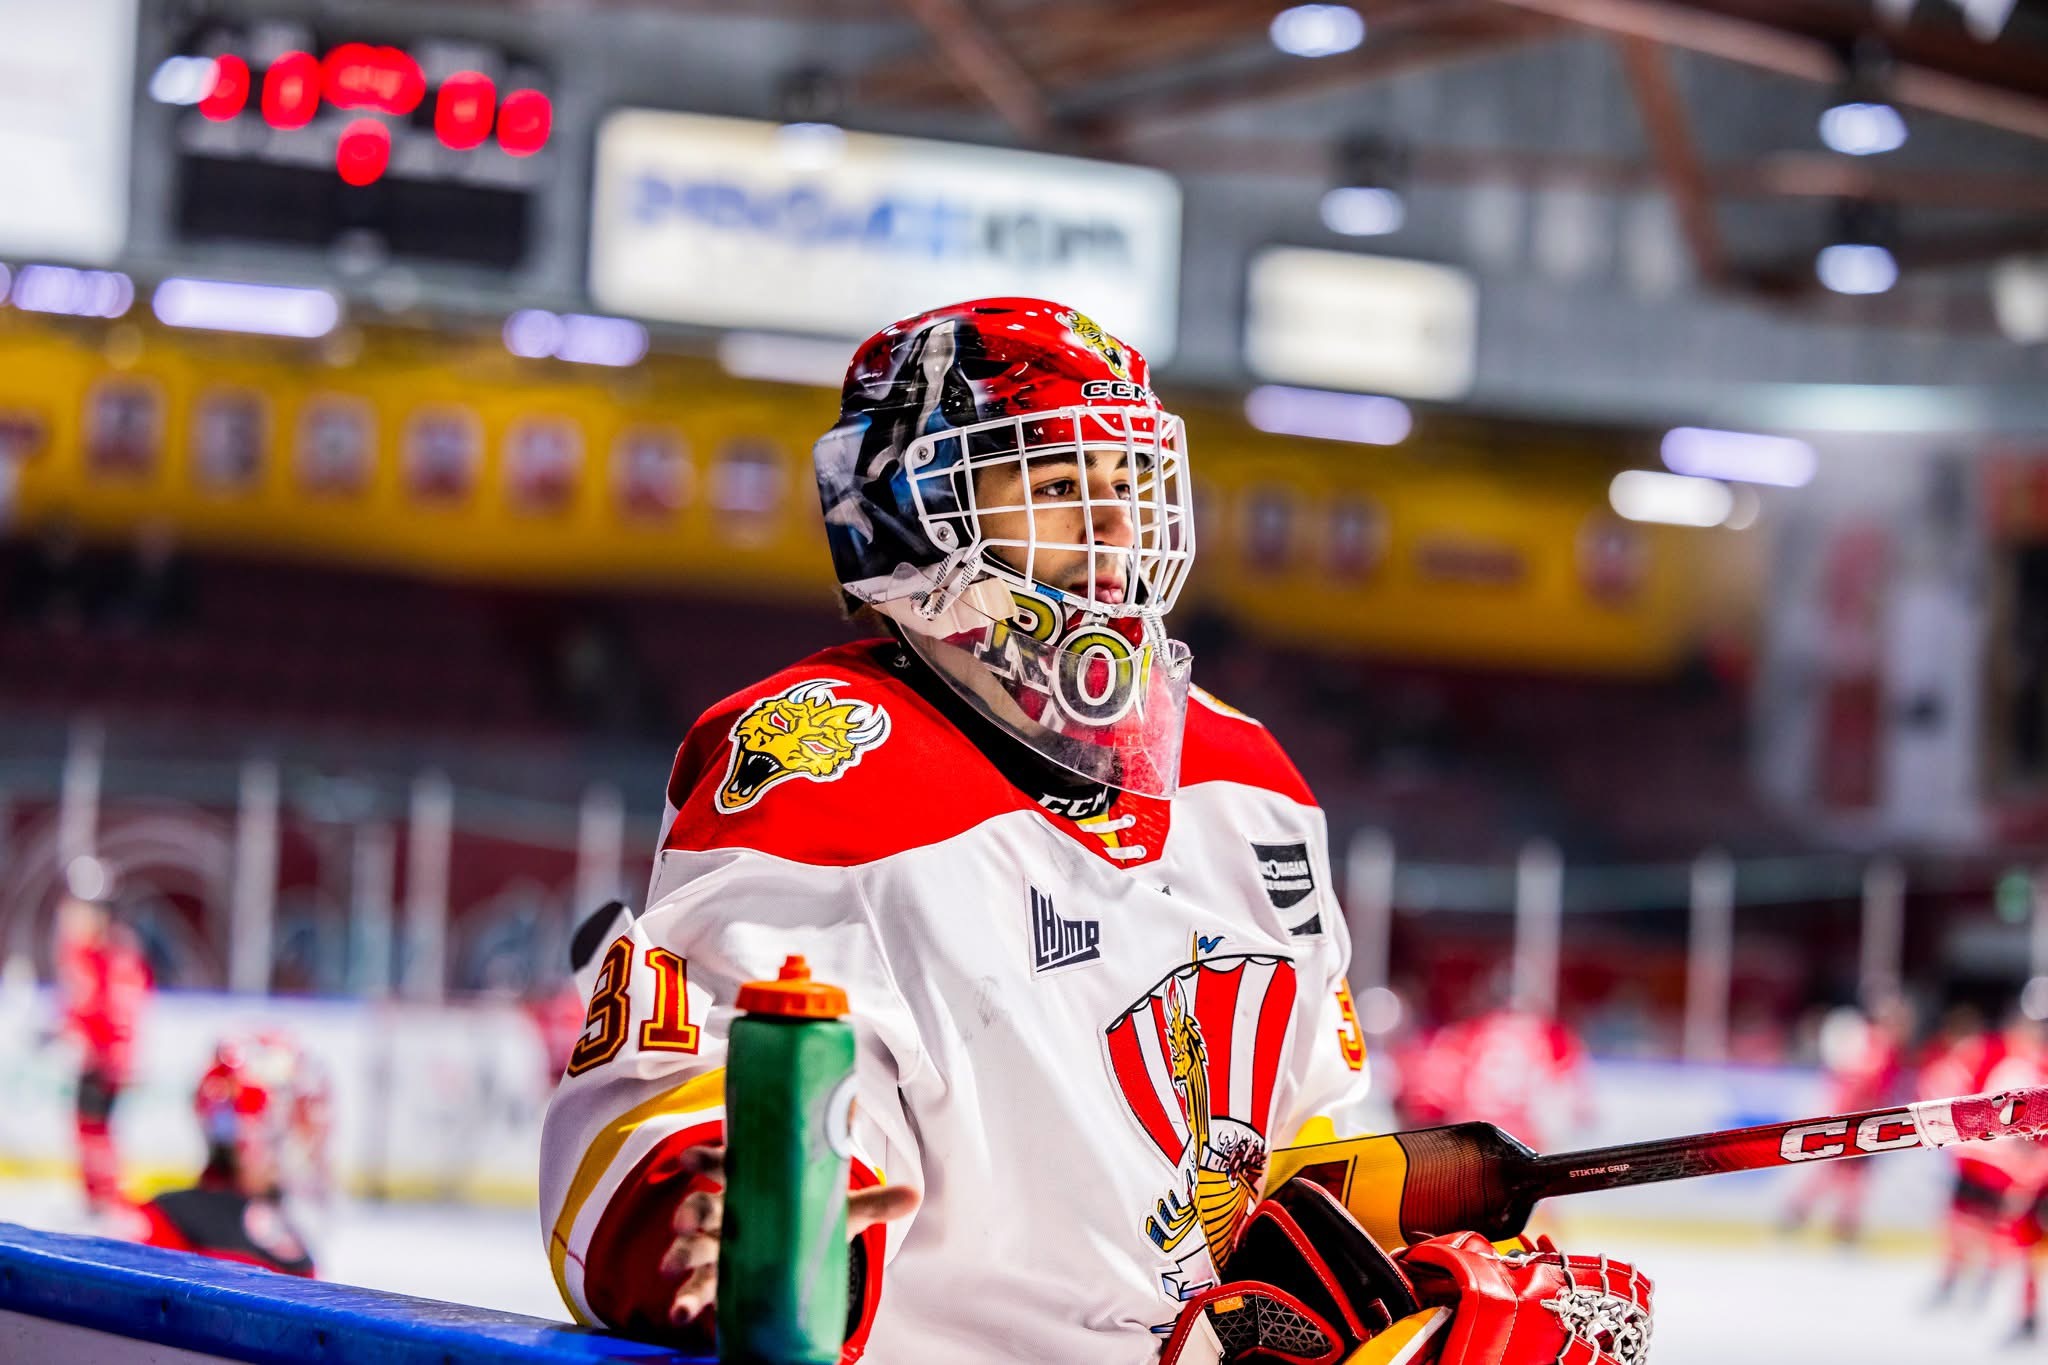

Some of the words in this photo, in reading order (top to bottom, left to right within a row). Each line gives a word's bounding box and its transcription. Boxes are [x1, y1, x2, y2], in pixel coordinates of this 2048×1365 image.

[567, 935, 700, 1078] 31
[1569, 1167, 1606, 1178] STIKTAK
[1607, 1164, 1630, 1173] GRIP
